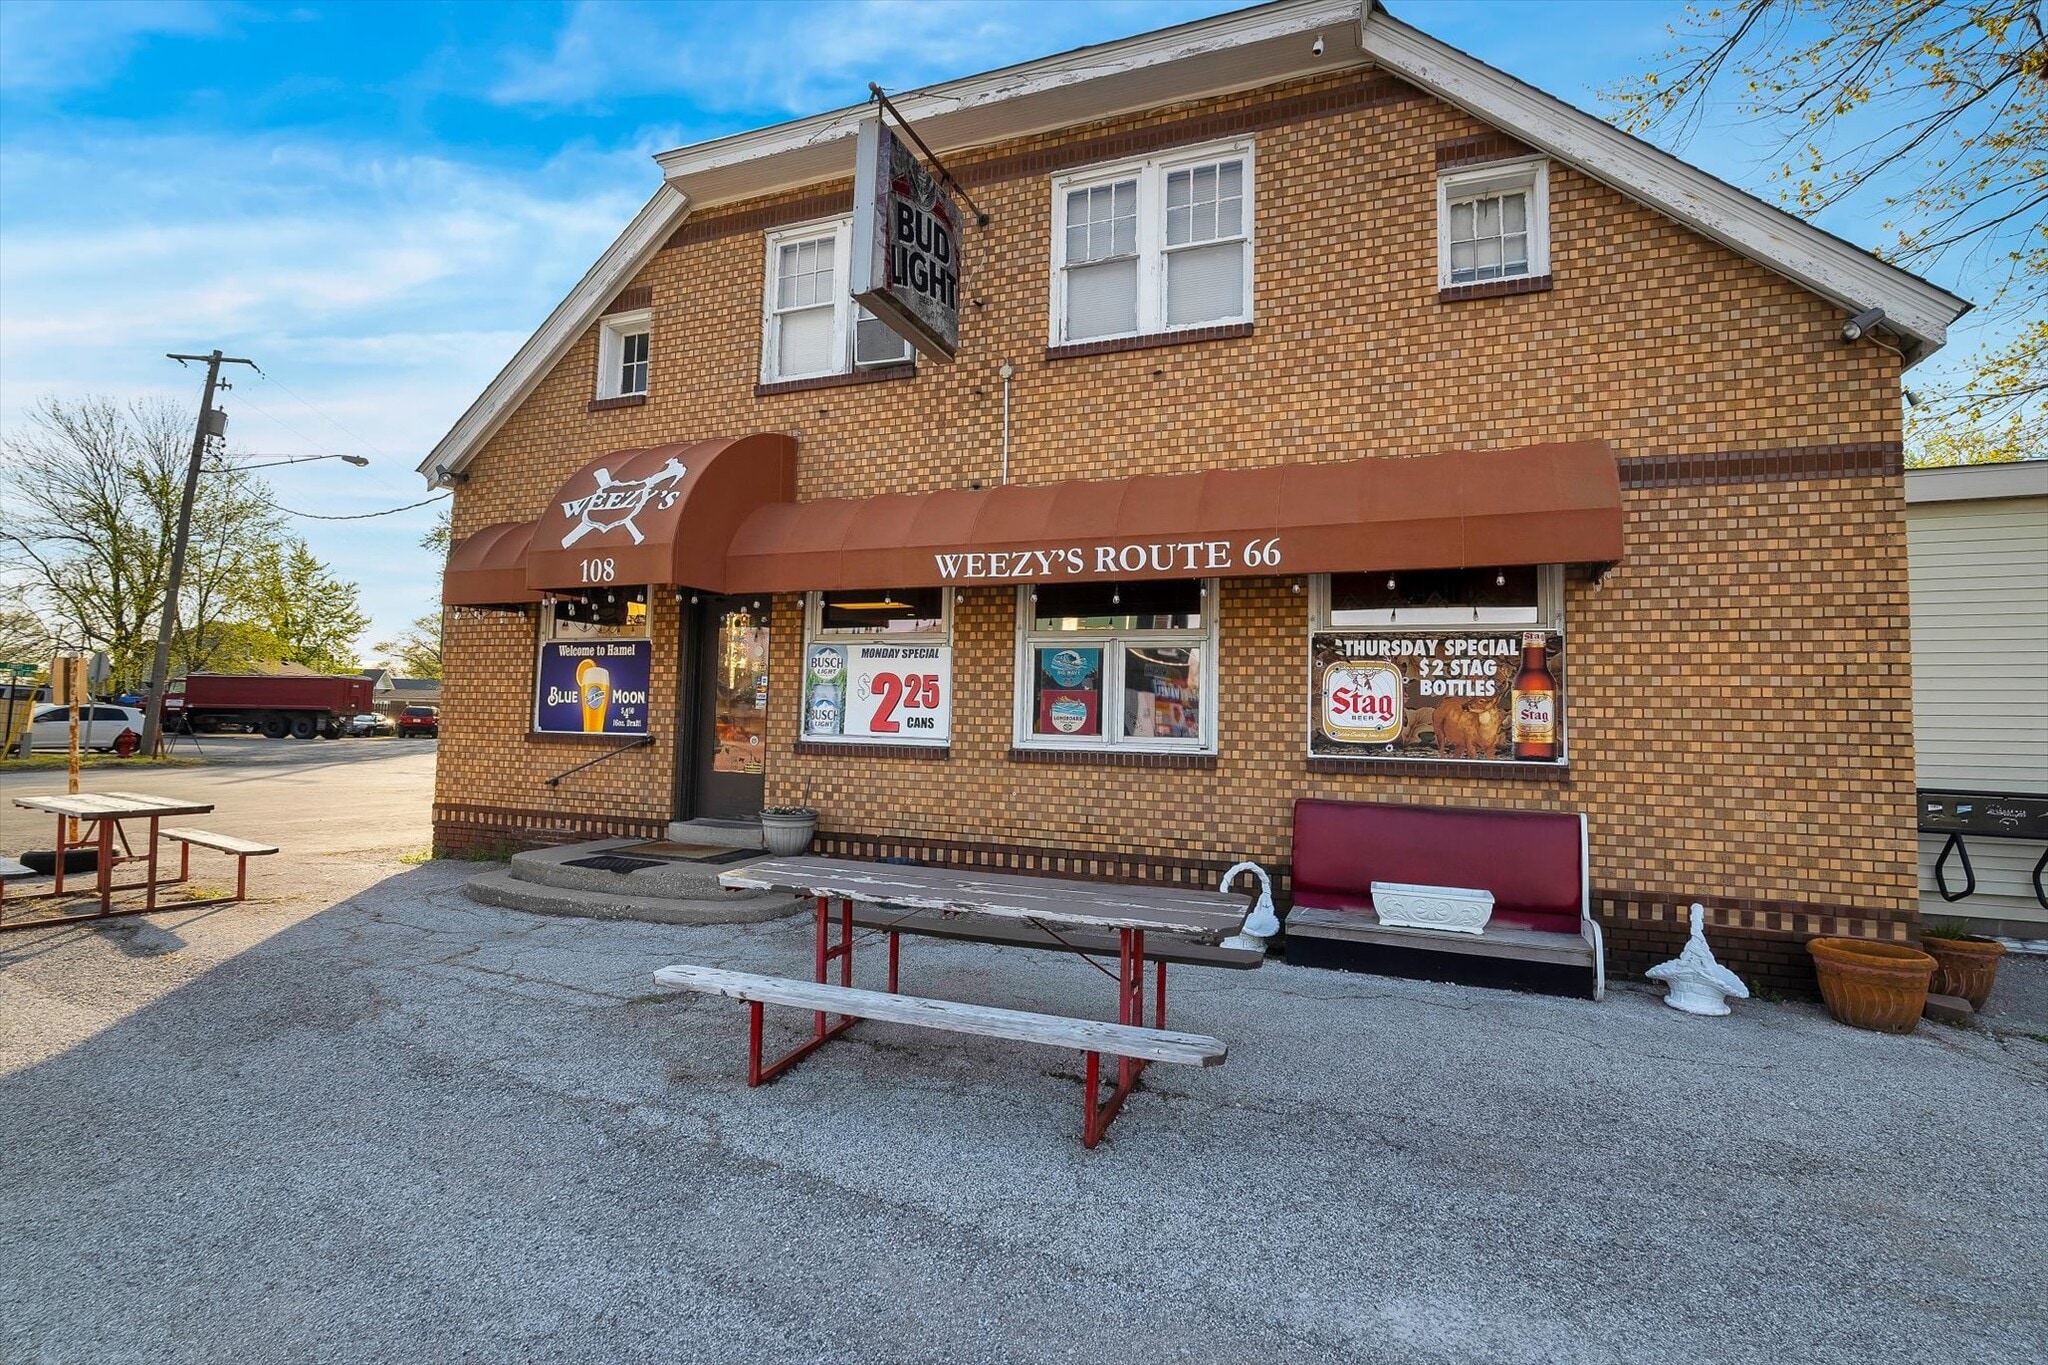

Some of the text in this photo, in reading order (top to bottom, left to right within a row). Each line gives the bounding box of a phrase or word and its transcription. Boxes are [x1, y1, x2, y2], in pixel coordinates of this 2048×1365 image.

[897, 201, 950, 266] BUD
[891, 244, 957, 311] LIGHT
[561, 488, 681, 519] WEEZY'S
[934, 537, 1282, 579] WEEZY'S ROUTE 66
[580, 557, 615, 583] 108
[1523, 632, 1545, 642] Stag
[558, 644, 636, 657] Welcome to Hamel
[861, 648, 940, 659] MONDAY SPECIAL
[1343, 639, 1519, 656] THURSDAY SPECIAL
[811, 657, 844, 669] BUSCH
[1450, 659, 1498, 676] STAG
[1420, 680, 1496, 697] BOTTLES
[1331, 686, 1394, 722] Stag
[811, 709, 839, 722] BUSCH
[906, 717, 935, 729] CANS
[1521, 708, 1549, 723] Stag
